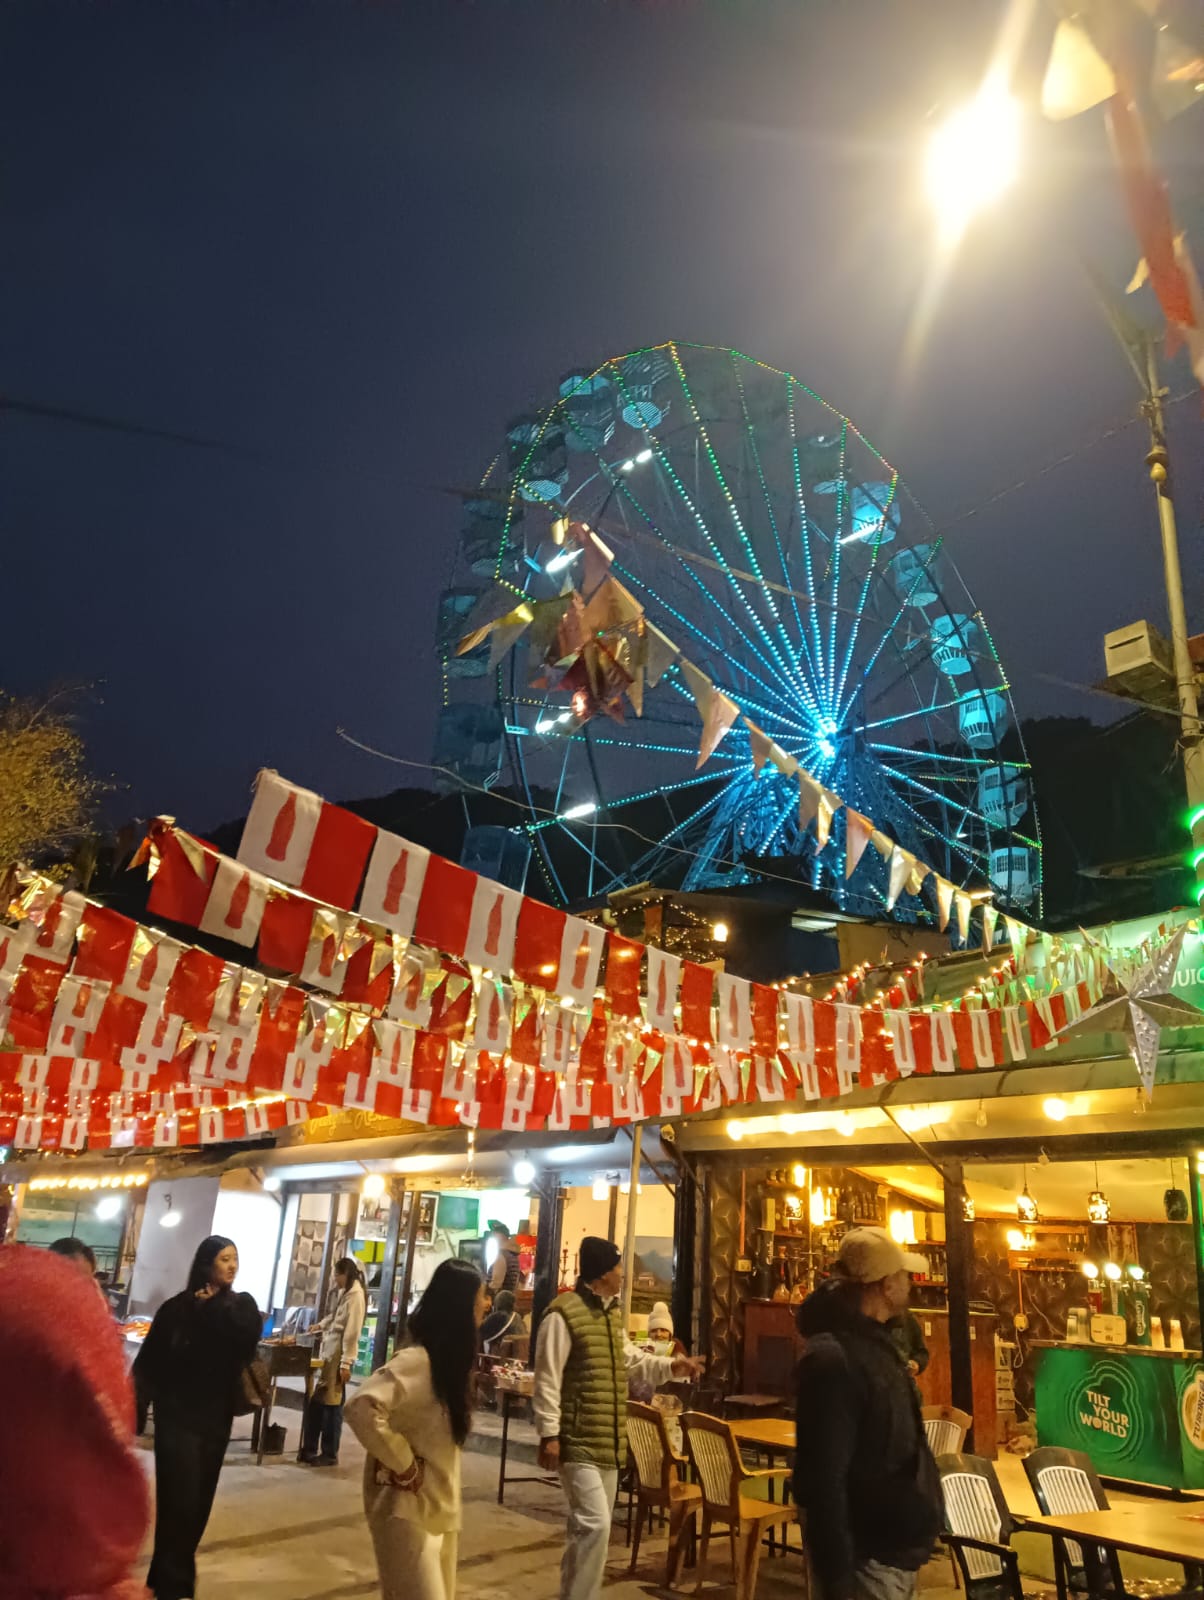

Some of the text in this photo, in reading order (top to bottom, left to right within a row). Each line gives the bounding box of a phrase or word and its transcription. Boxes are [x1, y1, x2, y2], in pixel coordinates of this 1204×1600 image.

[1086, 1390, 1111, 1408] TILT
[1080, 1411, 1127, 1438] WORLD
[1093, 1404, 1129, 1427] YOUR
